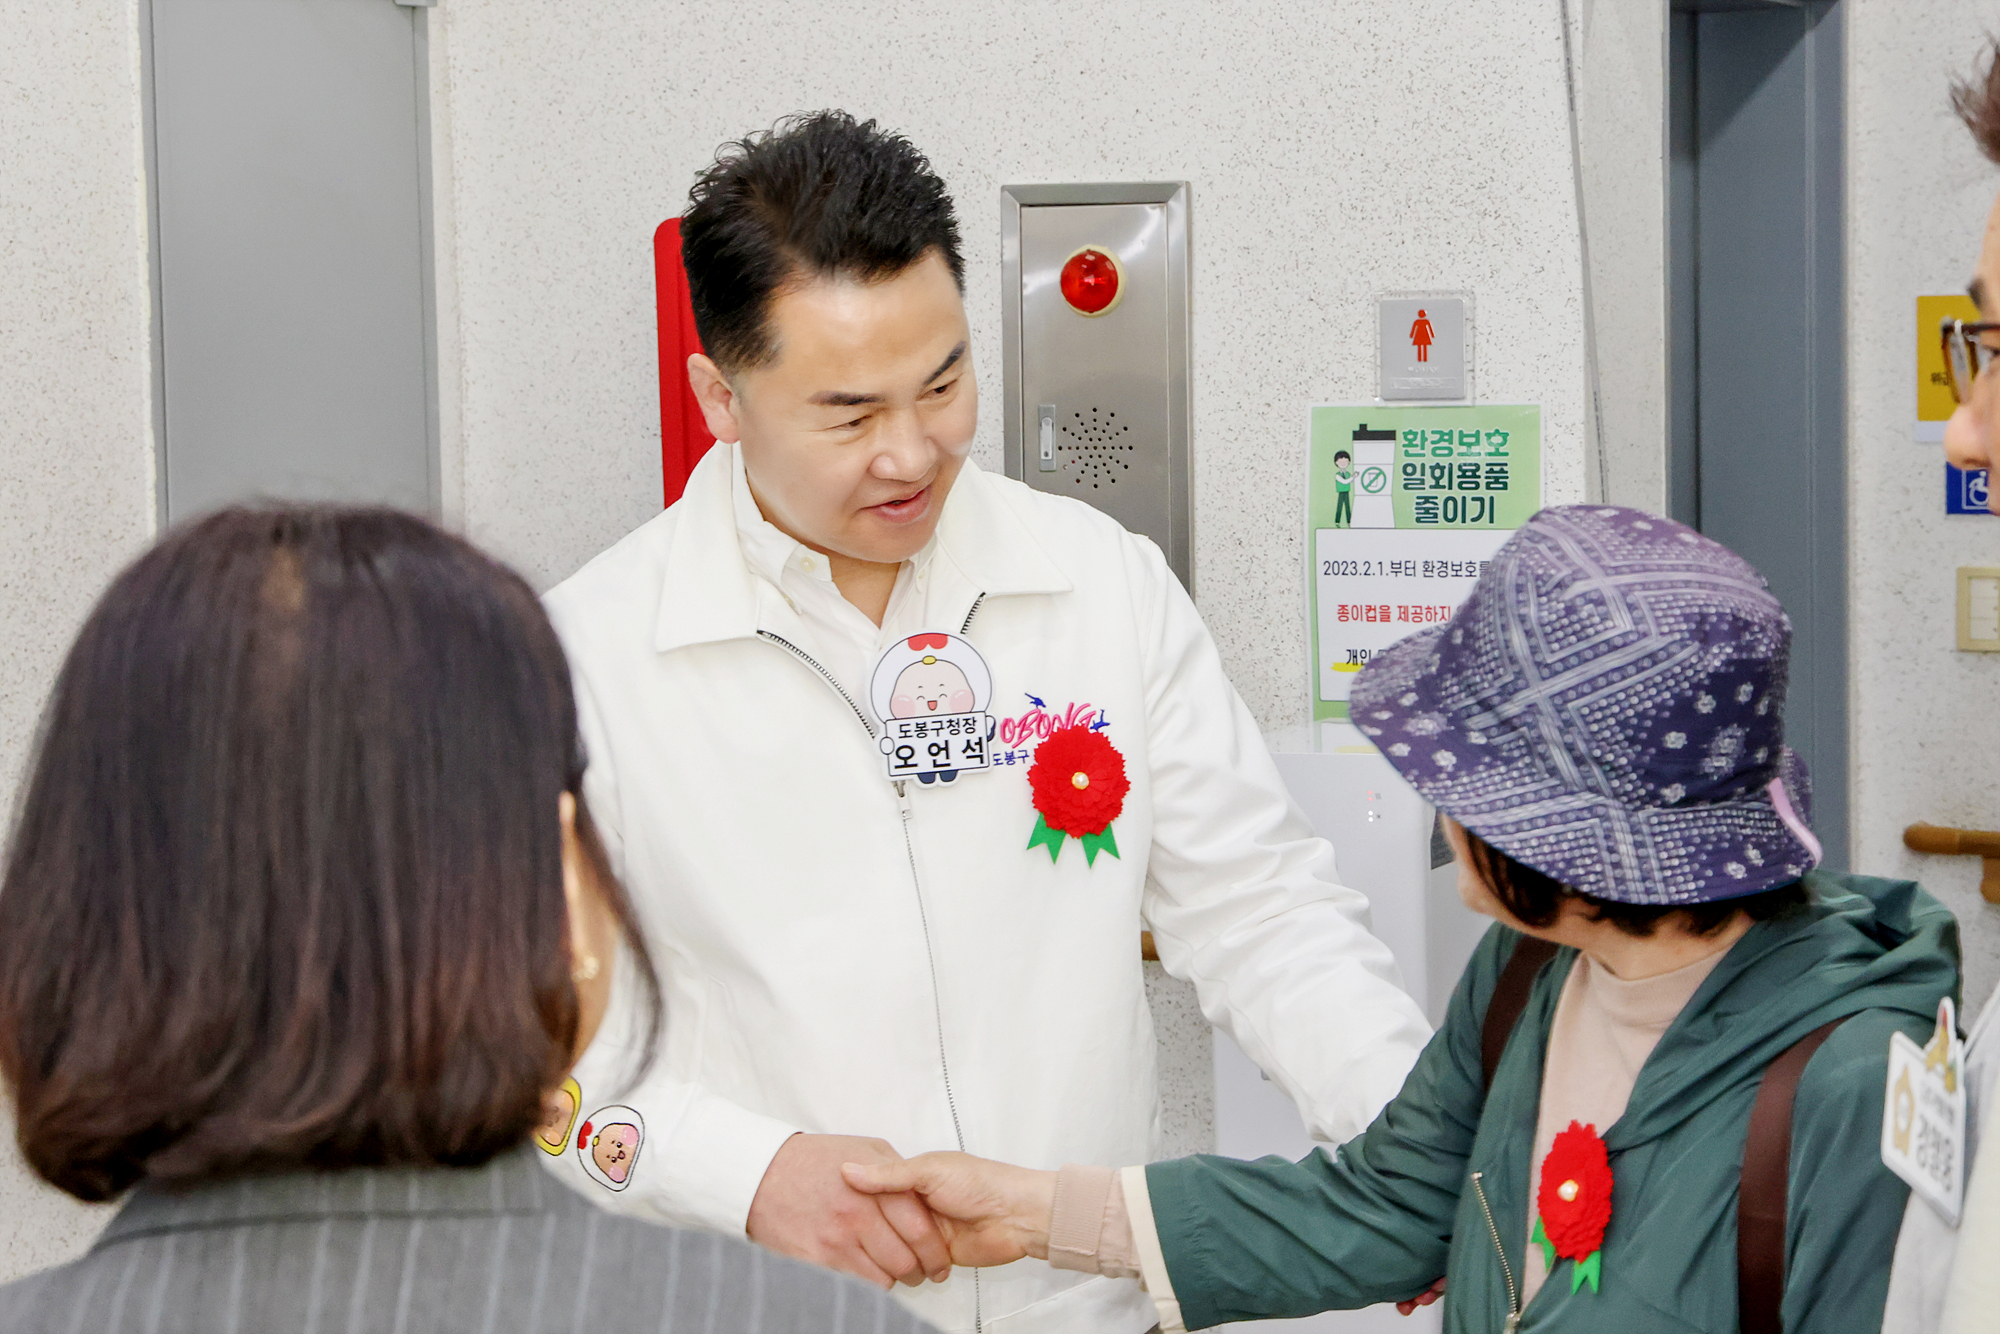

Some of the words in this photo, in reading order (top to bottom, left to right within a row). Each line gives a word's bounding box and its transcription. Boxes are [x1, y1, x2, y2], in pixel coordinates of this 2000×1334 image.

[1402, 429, 1509, 458] 환경보호
[1402, 462, 1509, 490] 일회용품
[1415, 495, 1494, 524] 줄이기
[1323, 560, 1416, 577] 2023.2.1.부터
[1337, 604, 1392, 623] 종이컵을
[898, 716, 977, 739] 도봉구청장
